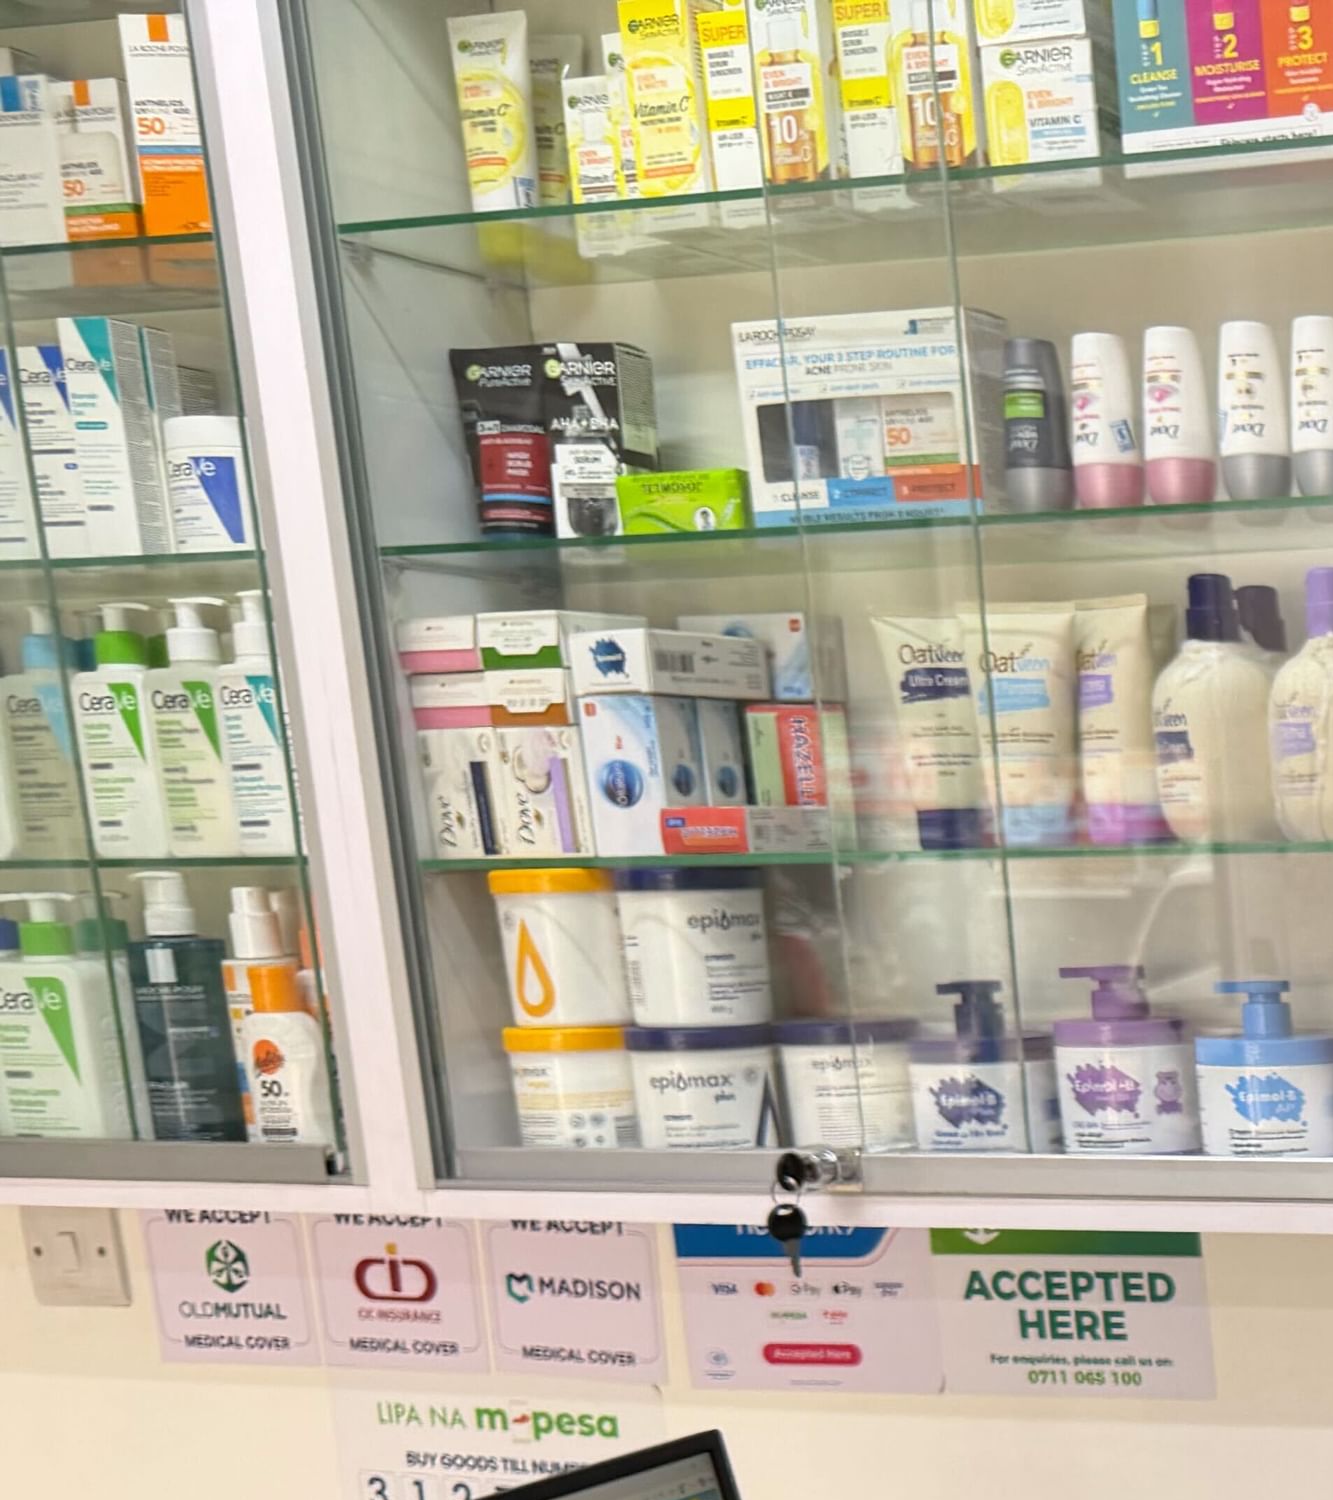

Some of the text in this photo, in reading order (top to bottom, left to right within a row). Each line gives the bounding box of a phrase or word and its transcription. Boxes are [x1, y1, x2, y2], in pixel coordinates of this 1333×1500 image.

[701, 24, 746, 44] SUPER
[1297, 24, 1314, 50] 3
[1150, 42, 1163, 66] 1
[1222, 33, 1239, 59] 2
[1000, 46, 1073, 70] GARNIER
[1276, 52, 1329, 68] PROTECT
[1129, 69, 1179, 85] CLEANSE
[1194, 59, 1261, 78] MOISTURISE
[1029, 115, 1070, 128] VITAMIN
[65, 358, 113, 372] CeraVe
[803, 352, 835, 366] YOUR
[845, 350, 875, 363] STEP
[875, 346, 929, 360] ROUTINE
[930, 344, 956, 357] FOR
[466, 364, 532, 381] GARNIER
[544, 359, 617, 379] GARNIER
[804, 360, 894, 376] ACNE PRONE SKIN
[779, 490, 821, 503] CLENSE
[908, 673, 970, 688] Ultra Cream
[79, 692, 137, 712] CeraVe
[150, 689, 211, 711] CeraVe
[219, 685, 275, 706] CeraVe
[438, 793, 459, 848] Dove
[518, 790, 538, 846] Dove
[260, 1081, 283, 1098] 50
[650, 1070, 733, 1094] epimax
[164, 1210, 272, 1225] WE ACCEPT
[334, 1212, 443, 1229] WE ACCEPT
[509, 1219, 625, 1236] WE ACCEPT
[538, 1276, 643, 1302] MADISON
[963, 1270, 1177, 1303] ACCEPTED
[178, 1301, 288, 1321] OLDMUTUAL
[376, 1309, 442, 1325] INSURANCE
[1017, 1309, 1130, 1341] HERE
[184, 1335, 291, 1351] MEDICAL COVER
[349, 1338, 459, 1356] MEDICAL COVER
[521, 1346, 637, 1367] MEDICAL COVER
[989, 1353, 1009, 1367] For
[1072, 1354, 1112, 1370] please
[1113, 1356, 1135, 1368] call
[1137, 1358, 1153, 1368] us
[1028, 1368, 1069, 1386] 0711
[1110, 1371, 1144, 1387] 100
[377, 1401, 424, 1428] LIPA
[428, 1405, 467, 1430] NA
[406, 1450, 438, 1468] BUY
[440, 1452, 498, 1473] GOODS
[500, 1457, 531, 1475] TILL
